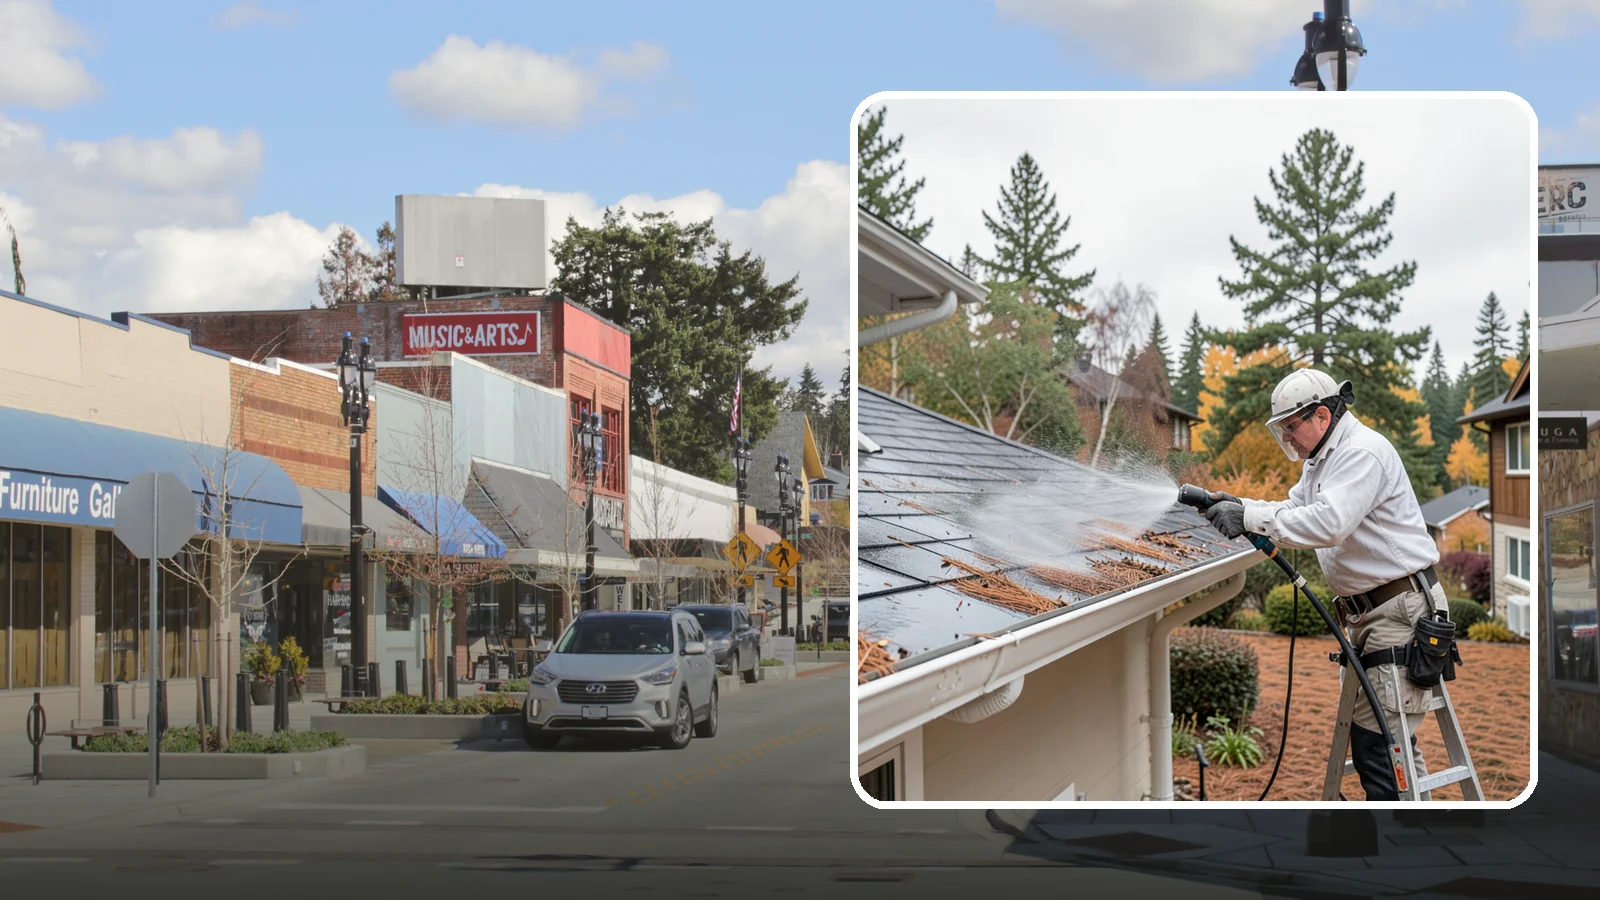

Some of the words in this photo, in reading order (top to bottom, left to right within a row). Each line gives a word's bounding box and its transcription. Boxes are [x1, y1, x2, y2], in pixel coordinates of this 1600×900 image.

[0, 471, 79, 515] Furniture
[89, 482, 122, 519] Gal
[453, 563, 479, 573] SUSHI
